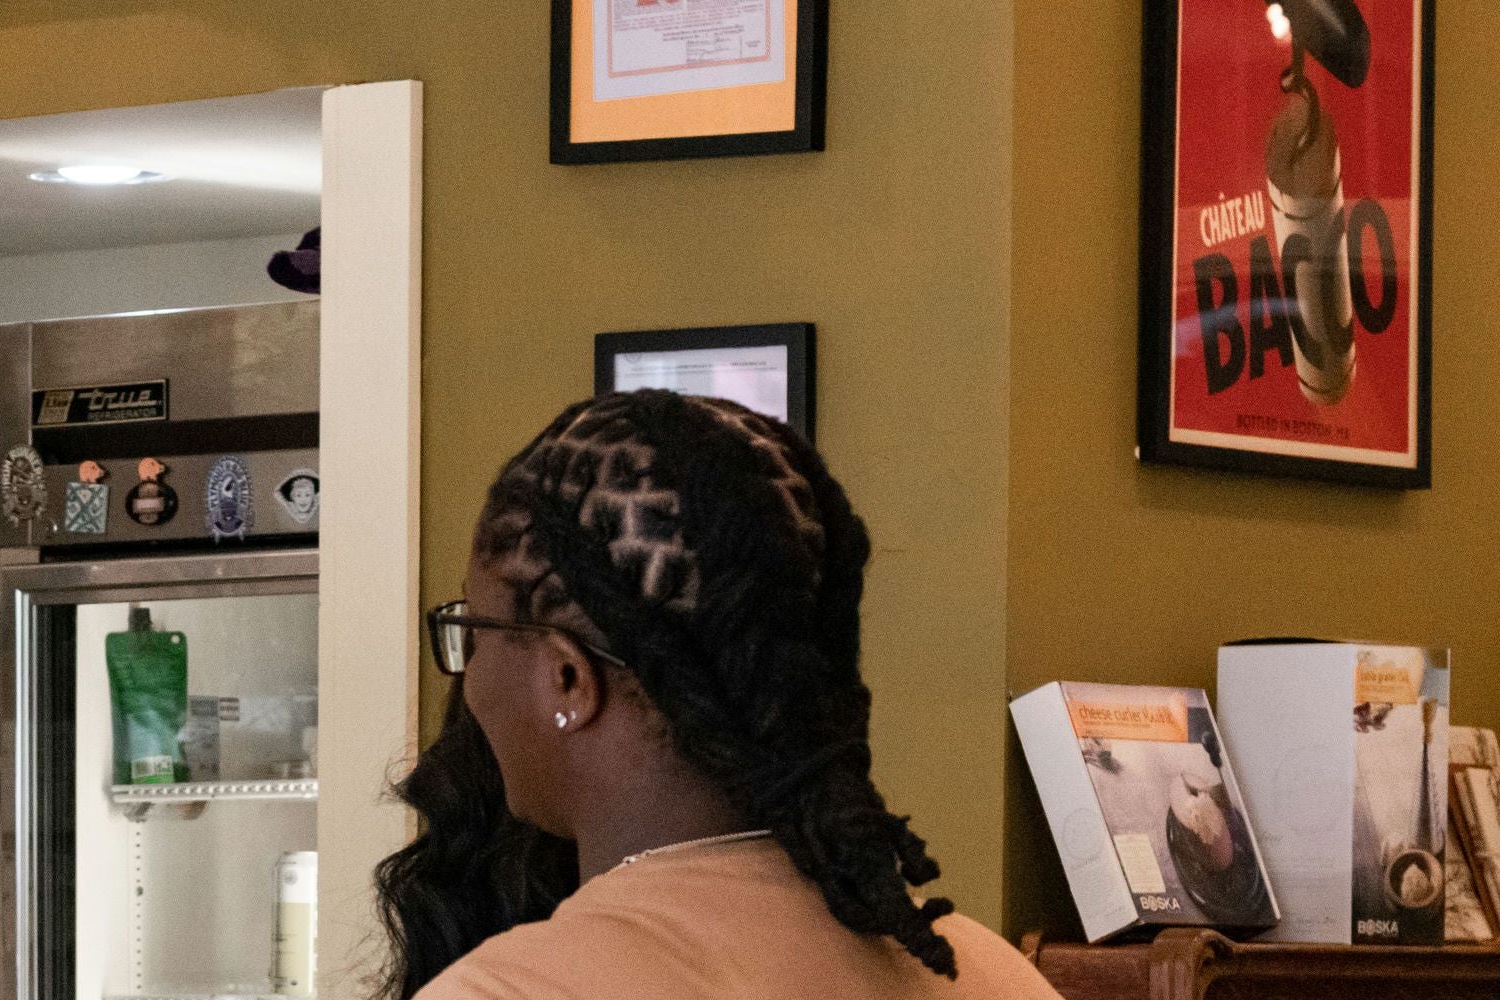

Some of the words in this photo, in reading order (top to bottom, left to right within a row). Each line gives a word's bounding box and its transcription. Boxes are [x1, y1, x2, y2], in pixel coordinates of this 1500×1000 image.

[1079, 704, 1112, 721] cheese
[1140, 895, 1181, 912] BOSKA
[1357, 919, 1399, 936] BOSKA
